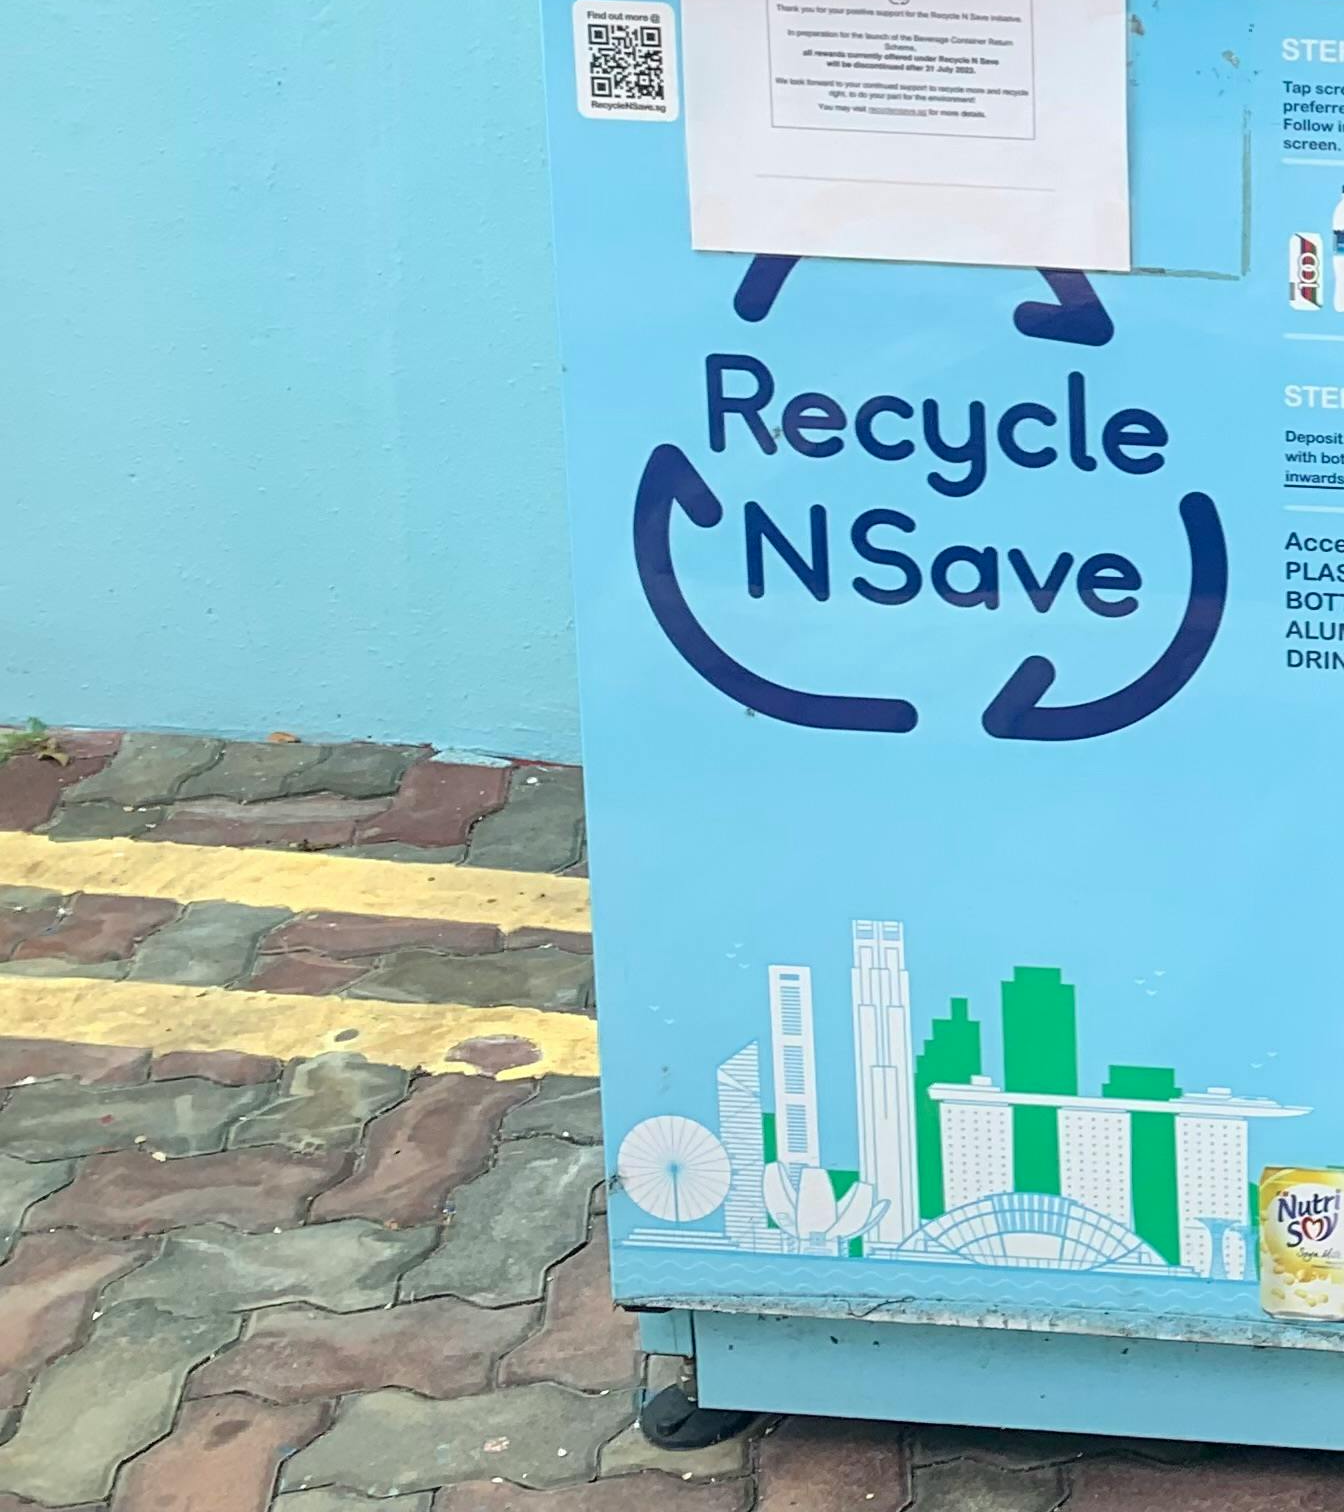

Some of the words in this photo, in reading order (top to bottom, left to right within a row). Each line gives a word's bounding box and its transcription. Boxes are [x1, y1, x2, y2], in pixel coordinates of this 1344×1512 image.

[587, 11, 606, 20] Find
[609, 12, 623, 20] out
[625, 14, 648, 22] more
[1283, 81, 1311, 98] Tap
[592, 100, 666, 113] RecycleNSave.sg
[1283, 118, 1333, 133] Follow
[1283, 139, 1341, 152] screen.
[705, 352, 1169, 498] Recycle
[1285, 430, 1343, 445] Deposit
[1285, 451, 1317, 464] with
[1285, 472, 1344, 485] inwards
[1277, 1189, 1341, 1226] Nutri
